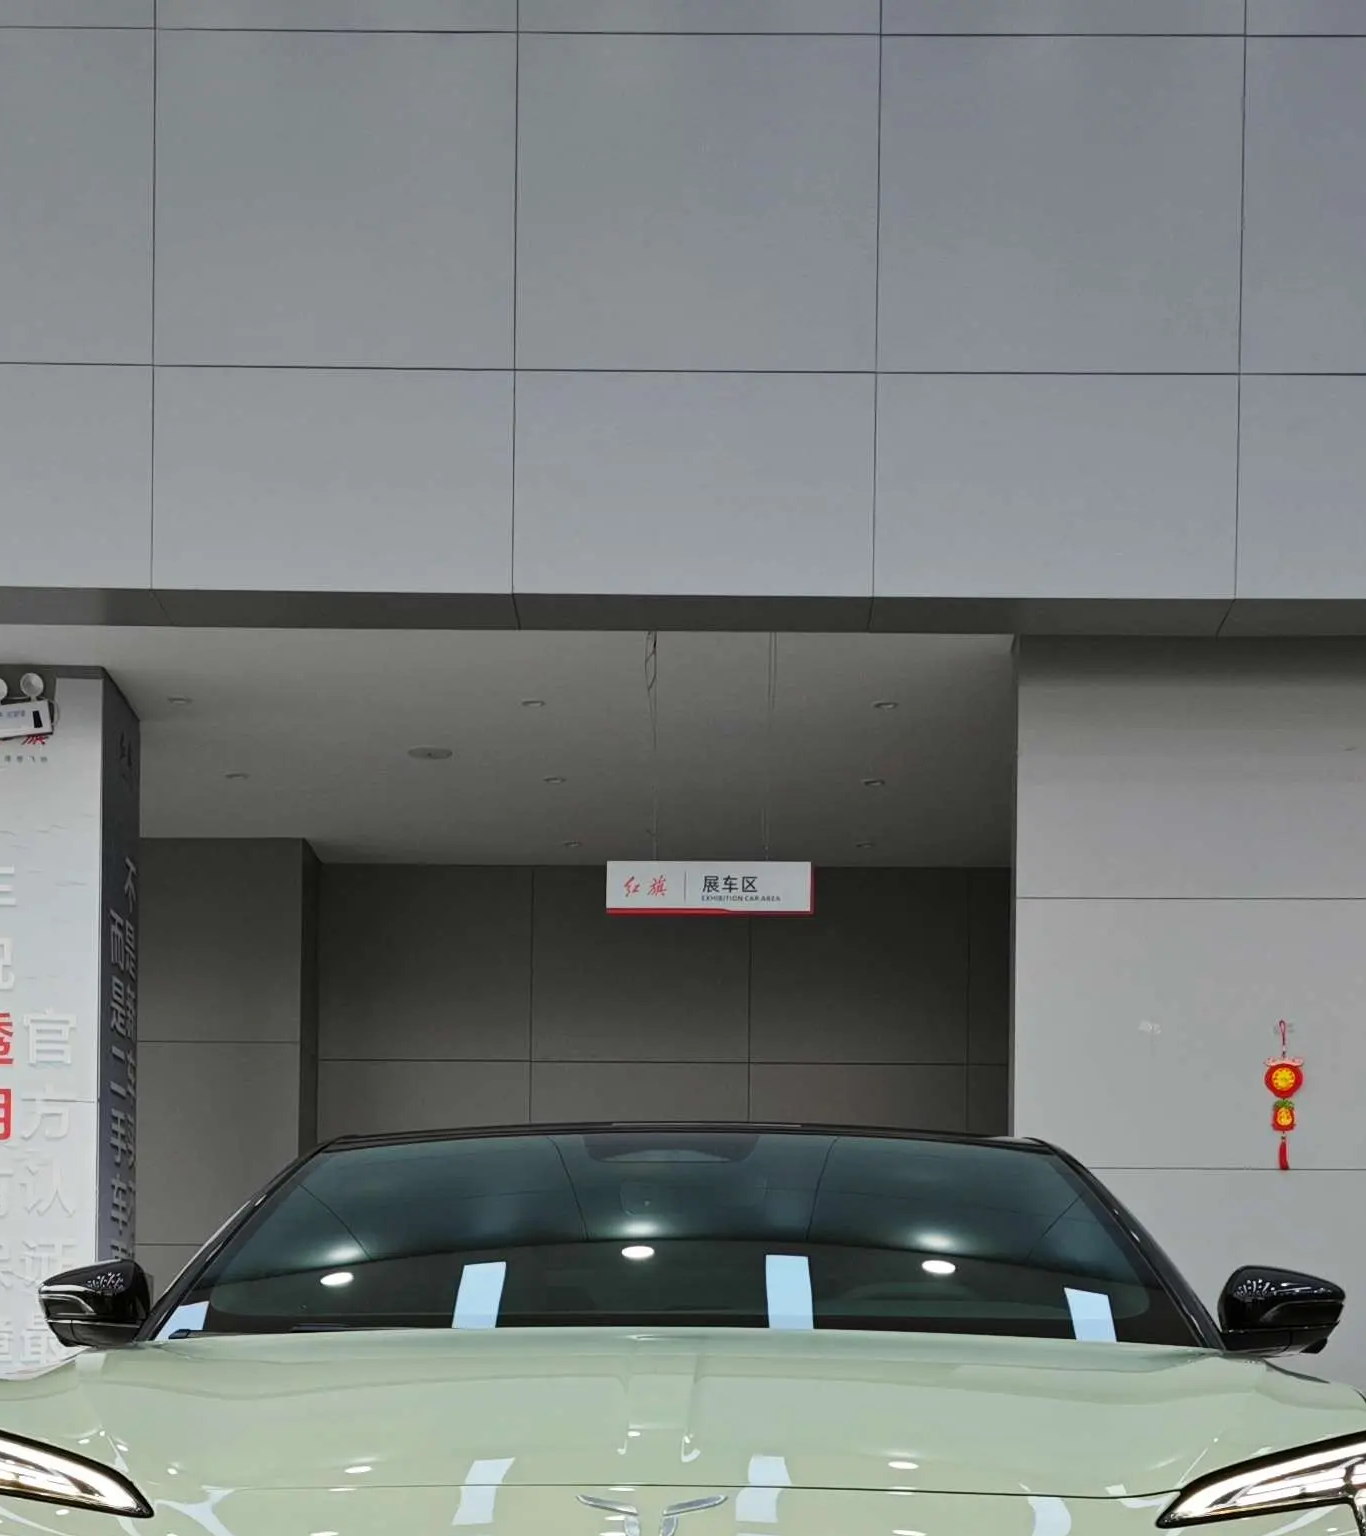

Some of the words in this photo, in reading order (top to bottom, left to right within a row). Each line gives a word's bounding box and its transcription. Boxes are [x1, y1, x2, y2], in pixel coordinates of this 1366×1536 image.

[623, 874, 668, 898] 红旗
[701, 875, 759, 894] 展车区
